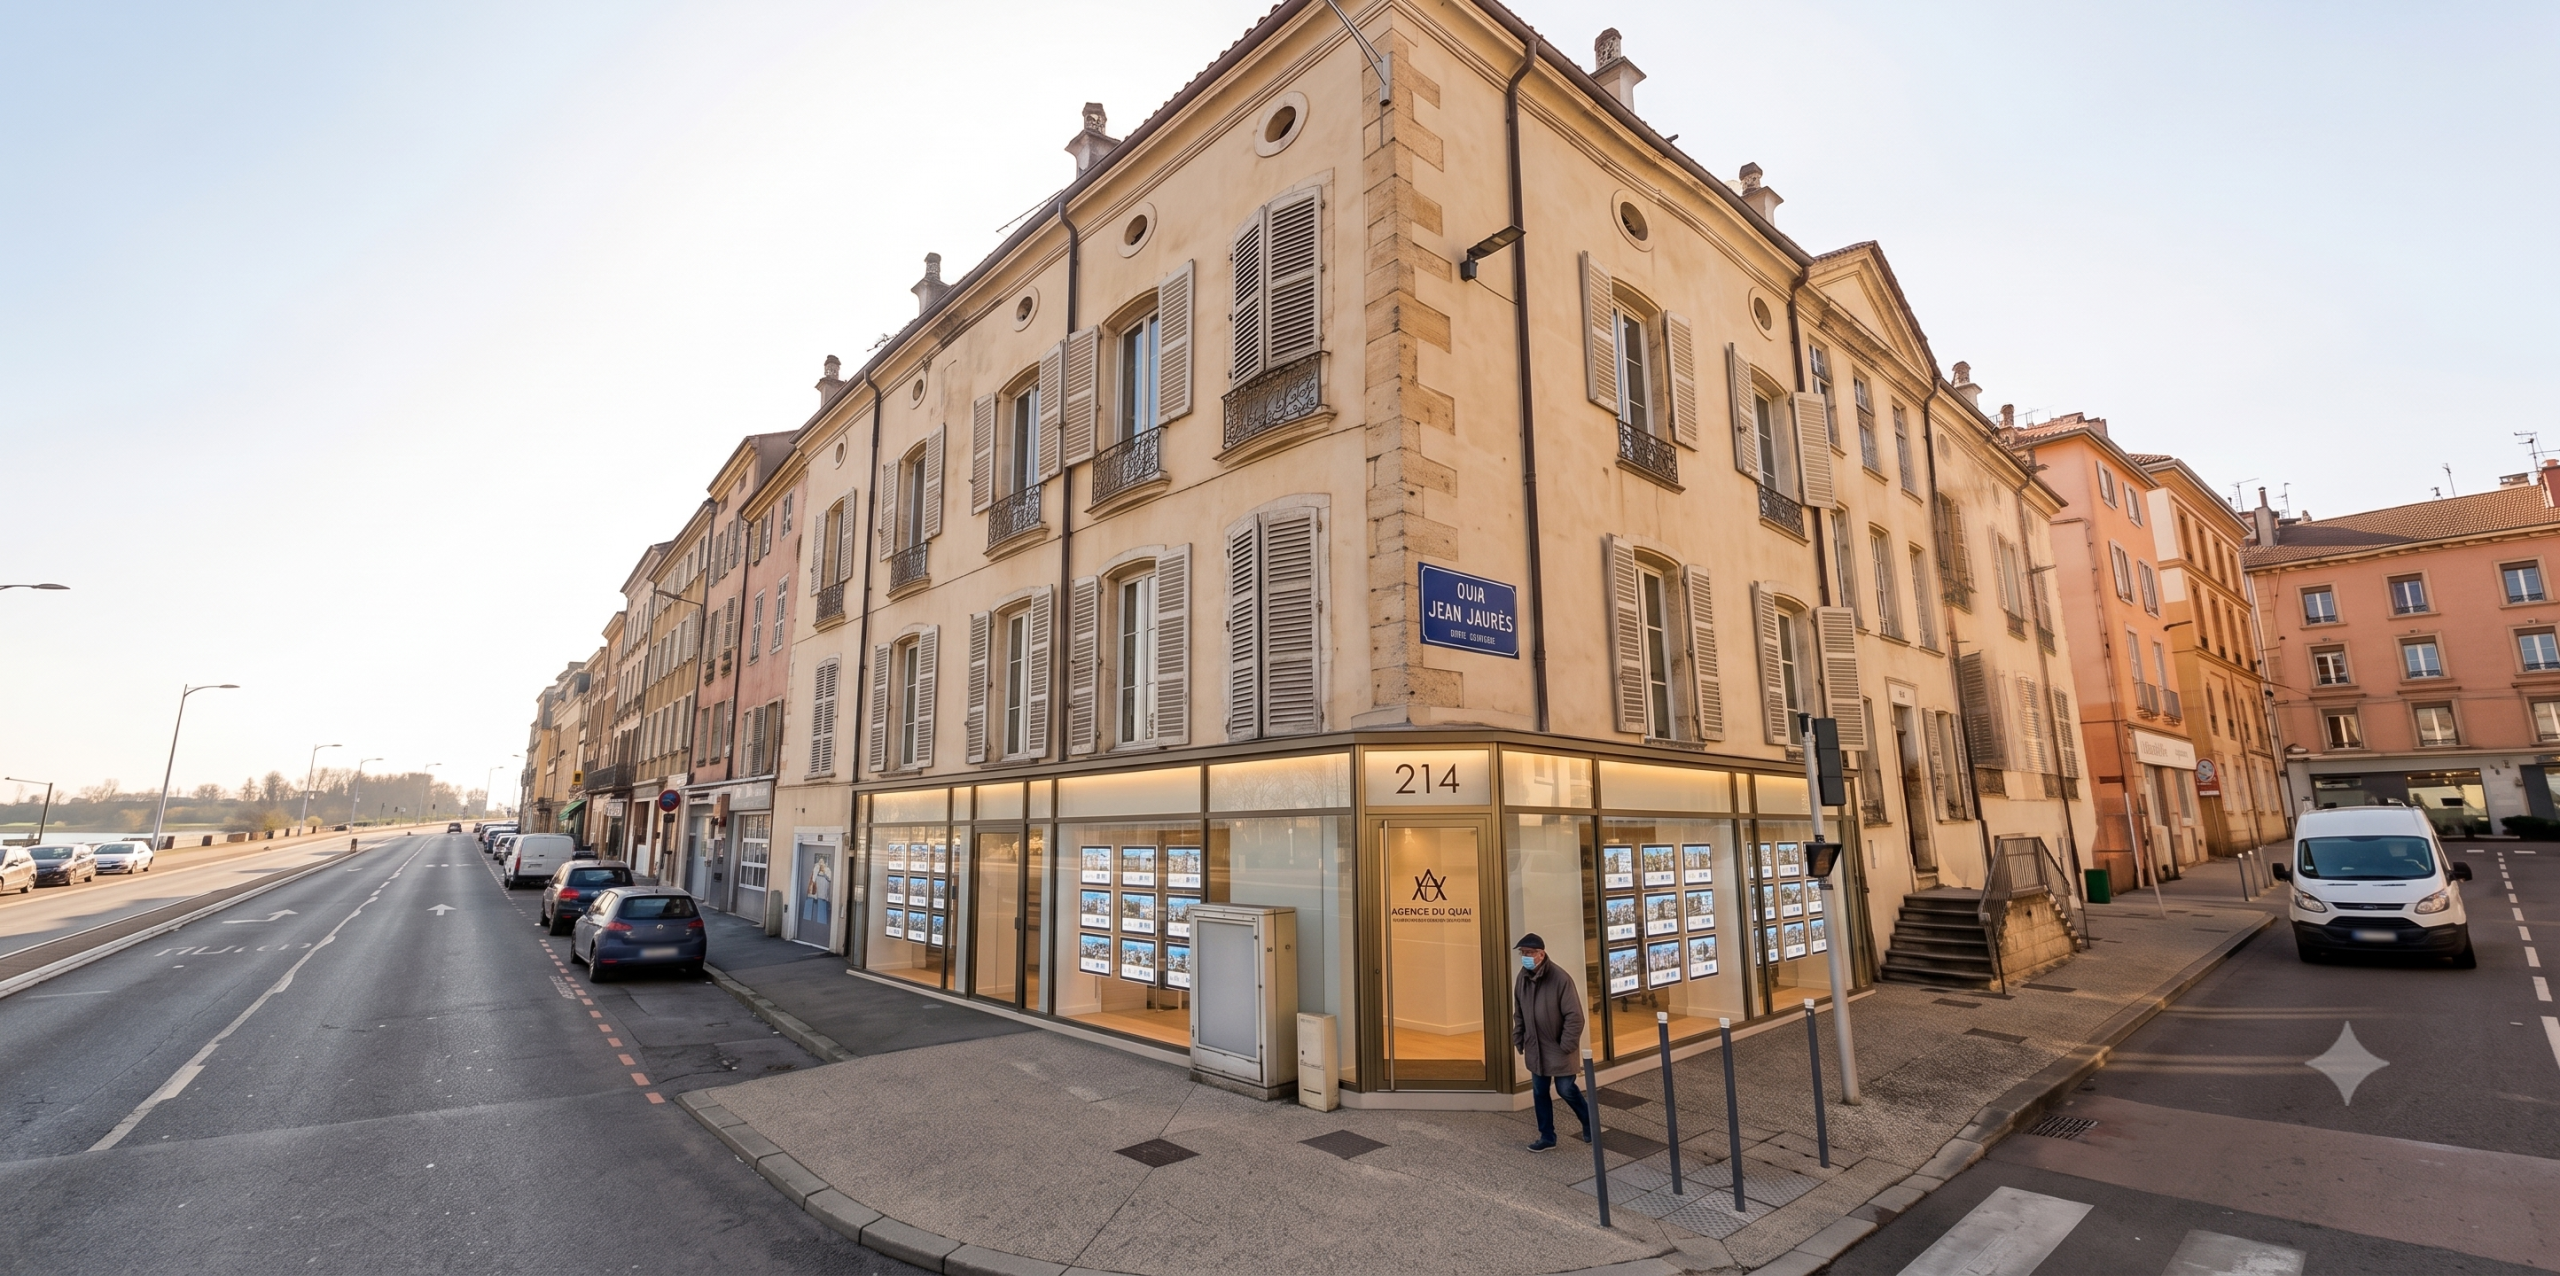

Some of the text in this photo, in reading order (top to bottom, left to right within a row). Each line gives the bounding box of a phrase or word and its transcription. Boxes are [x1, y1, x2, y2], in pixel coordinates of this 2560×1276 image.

[1428, 600, 1462, 623] JEAN
[1395, 763, 1460, 794] 214
[1391, 908, 1472, 917] AGENCE DU QUAI
